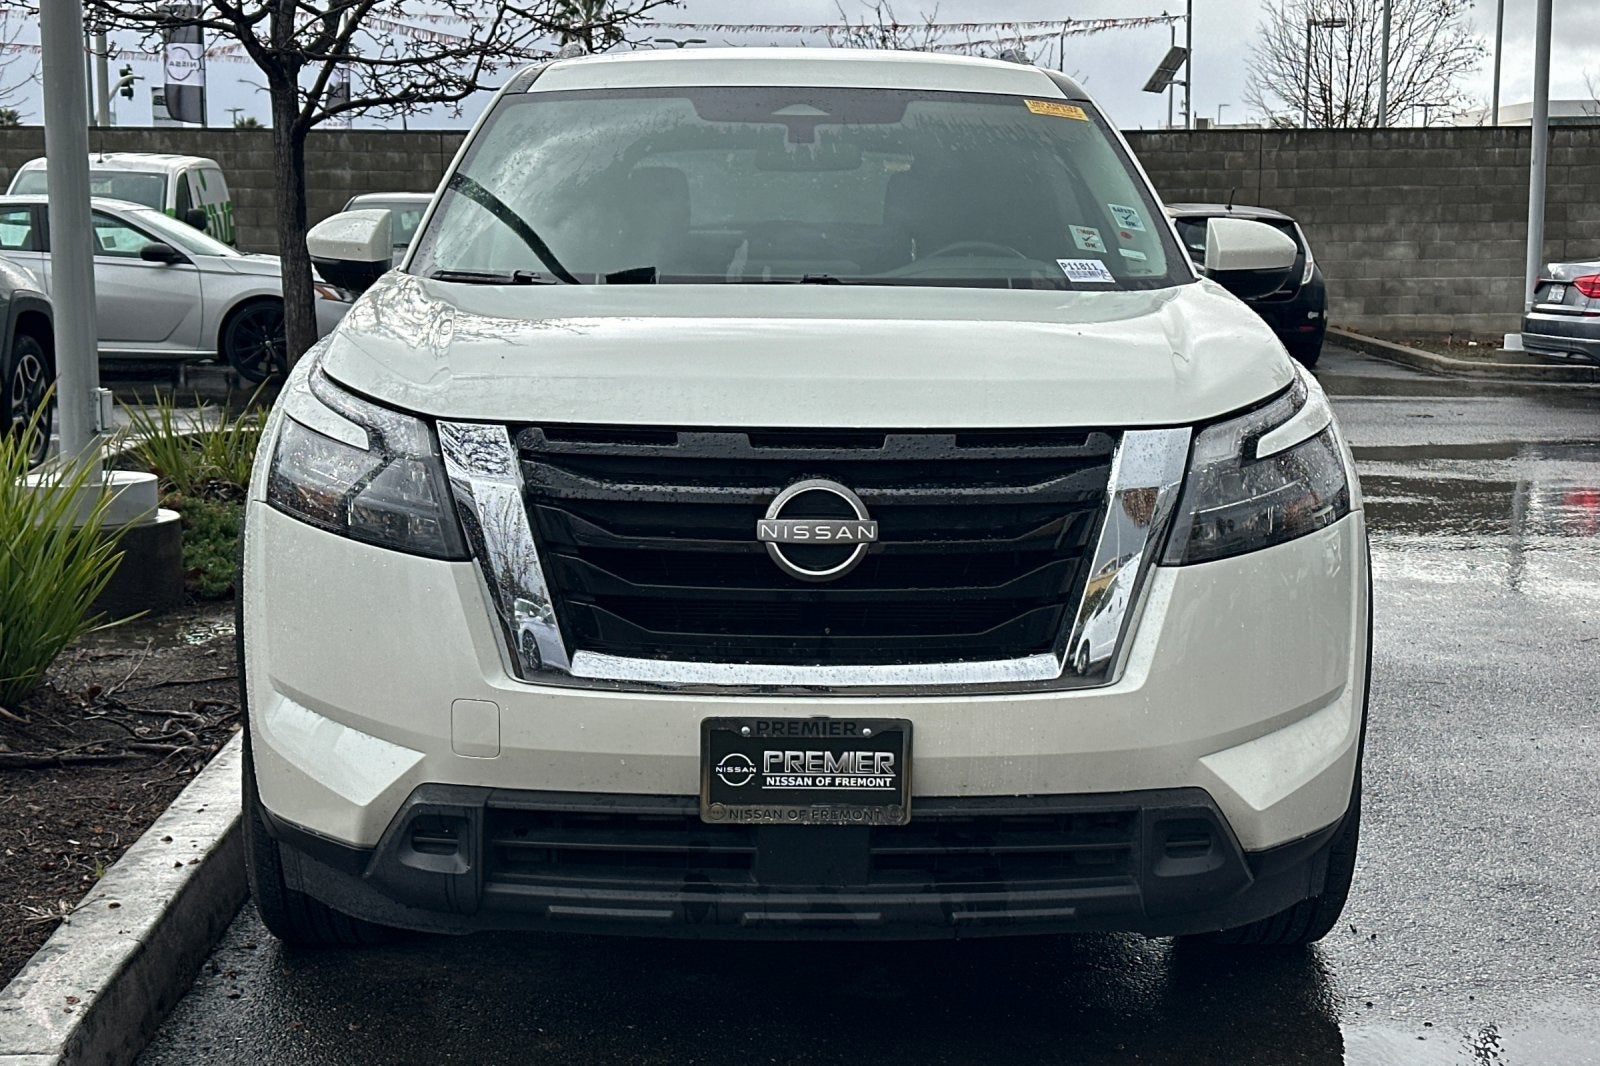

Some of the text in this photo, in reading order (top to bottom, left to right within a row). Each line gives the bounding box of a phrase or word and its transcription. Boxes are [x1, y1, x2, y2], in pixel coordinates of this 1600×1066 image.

[761, 524, 875, 540] NISSAN
[756, 720, 858, 736] PREMIER
[715, 765, 757, 773] NISSAN
[763, 750, 895, 775] PREMIER
[766, 776, 892, 787] NISSAN OF FREMONT
[729, 808, 783, 820] NISSAN
[787, 809, 806, 820] OF
[811, 809, 882, 821] FREMONT
